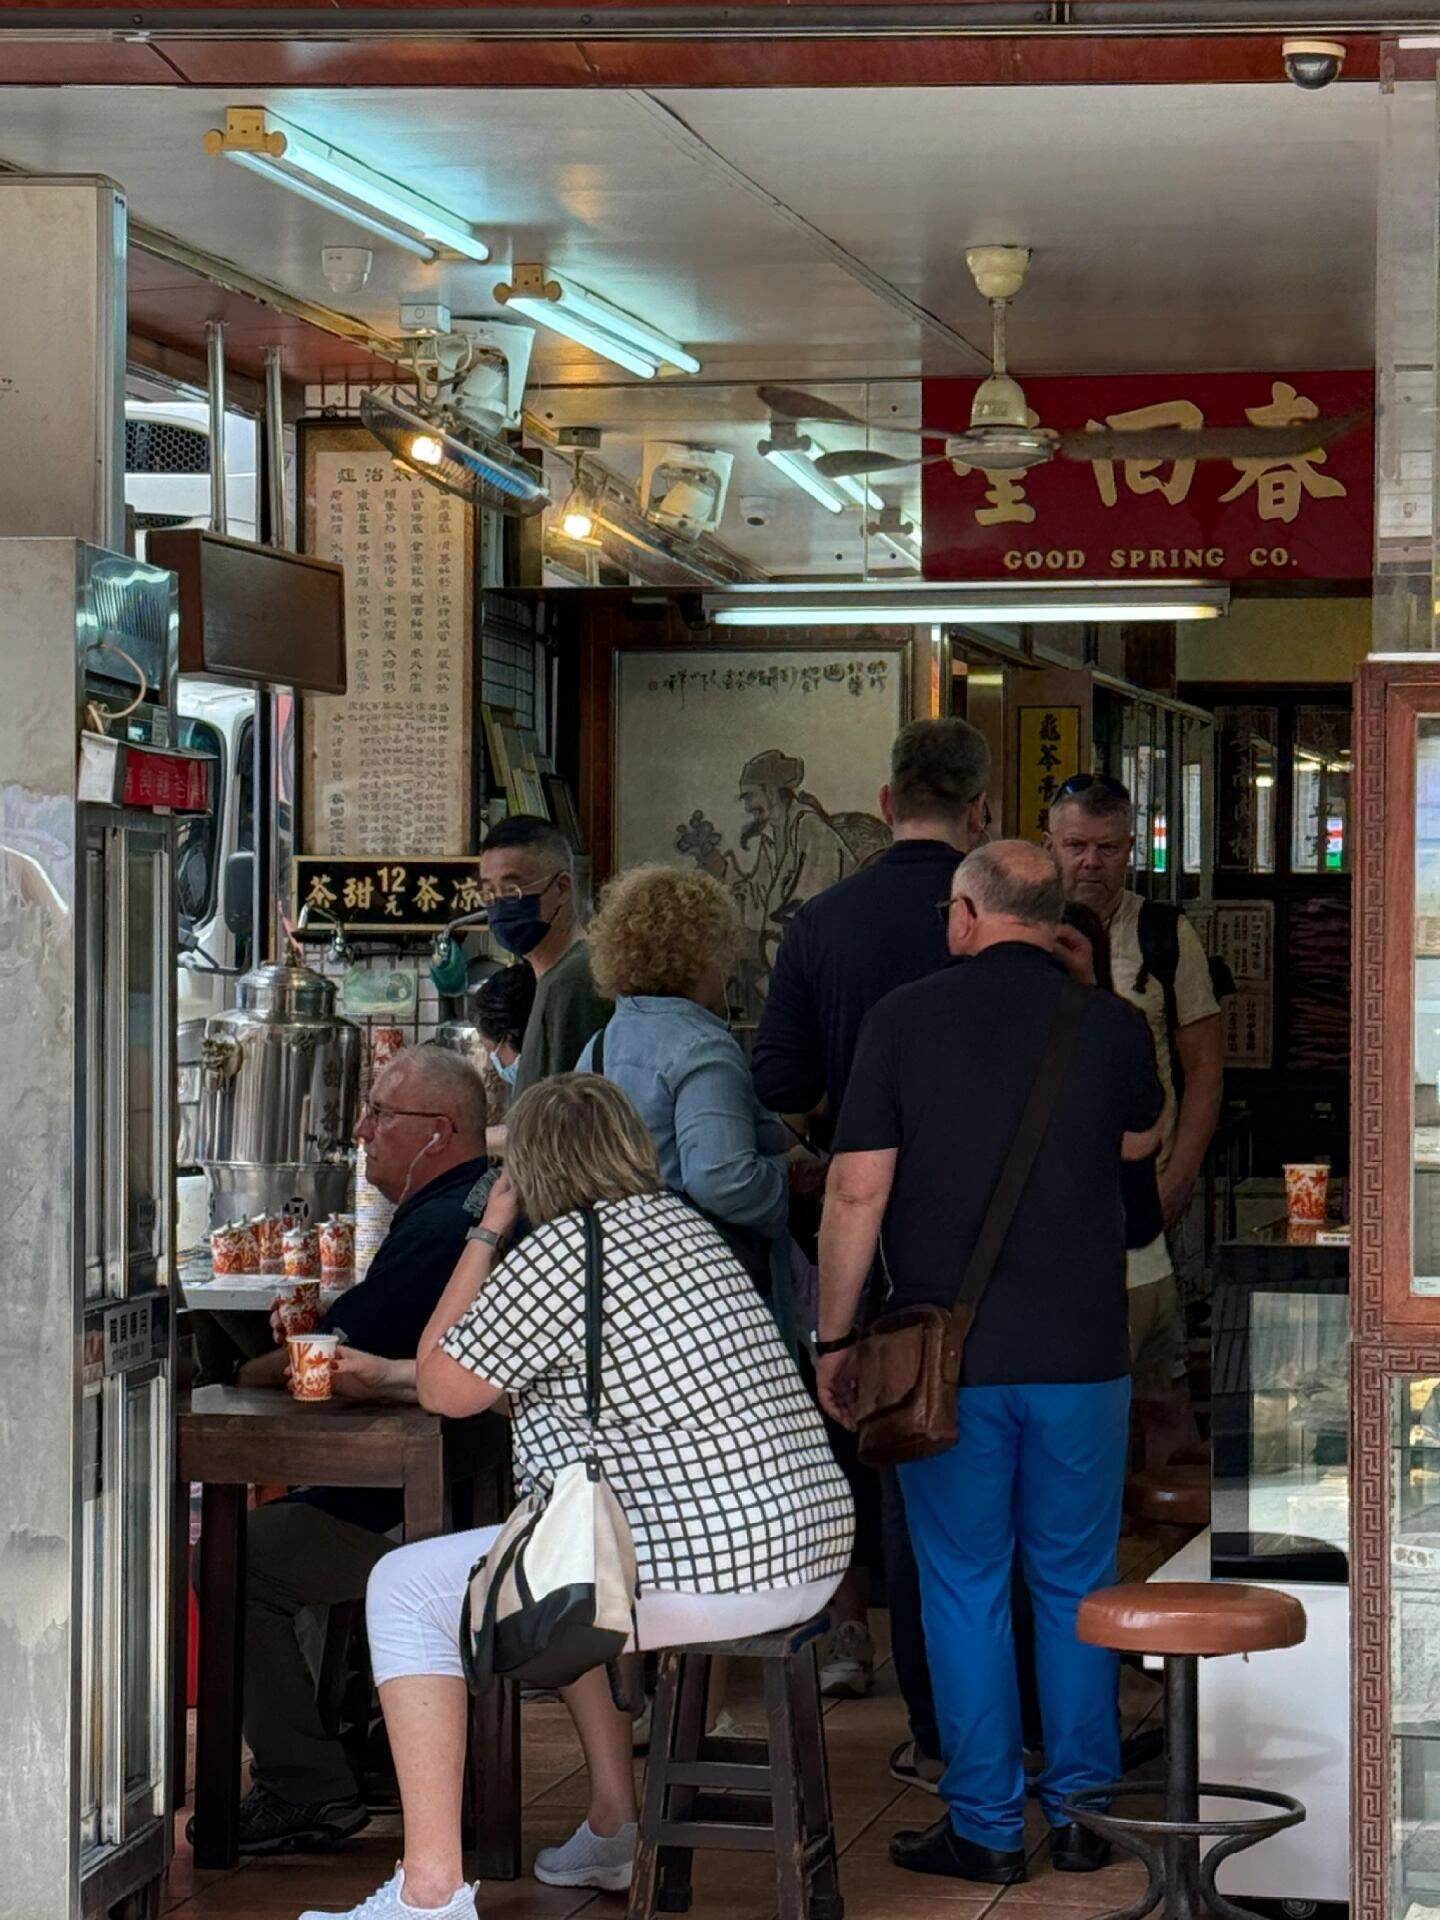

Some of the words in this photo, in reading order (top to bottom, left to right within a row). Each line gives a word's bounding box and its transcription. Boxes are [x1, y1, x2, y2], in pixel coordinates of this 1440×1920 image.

[1003, 549, 1086, 570] GOOD
[1110, 547, 1226, 569] SPRING
[1249, 547, 1298, 567] CO.
